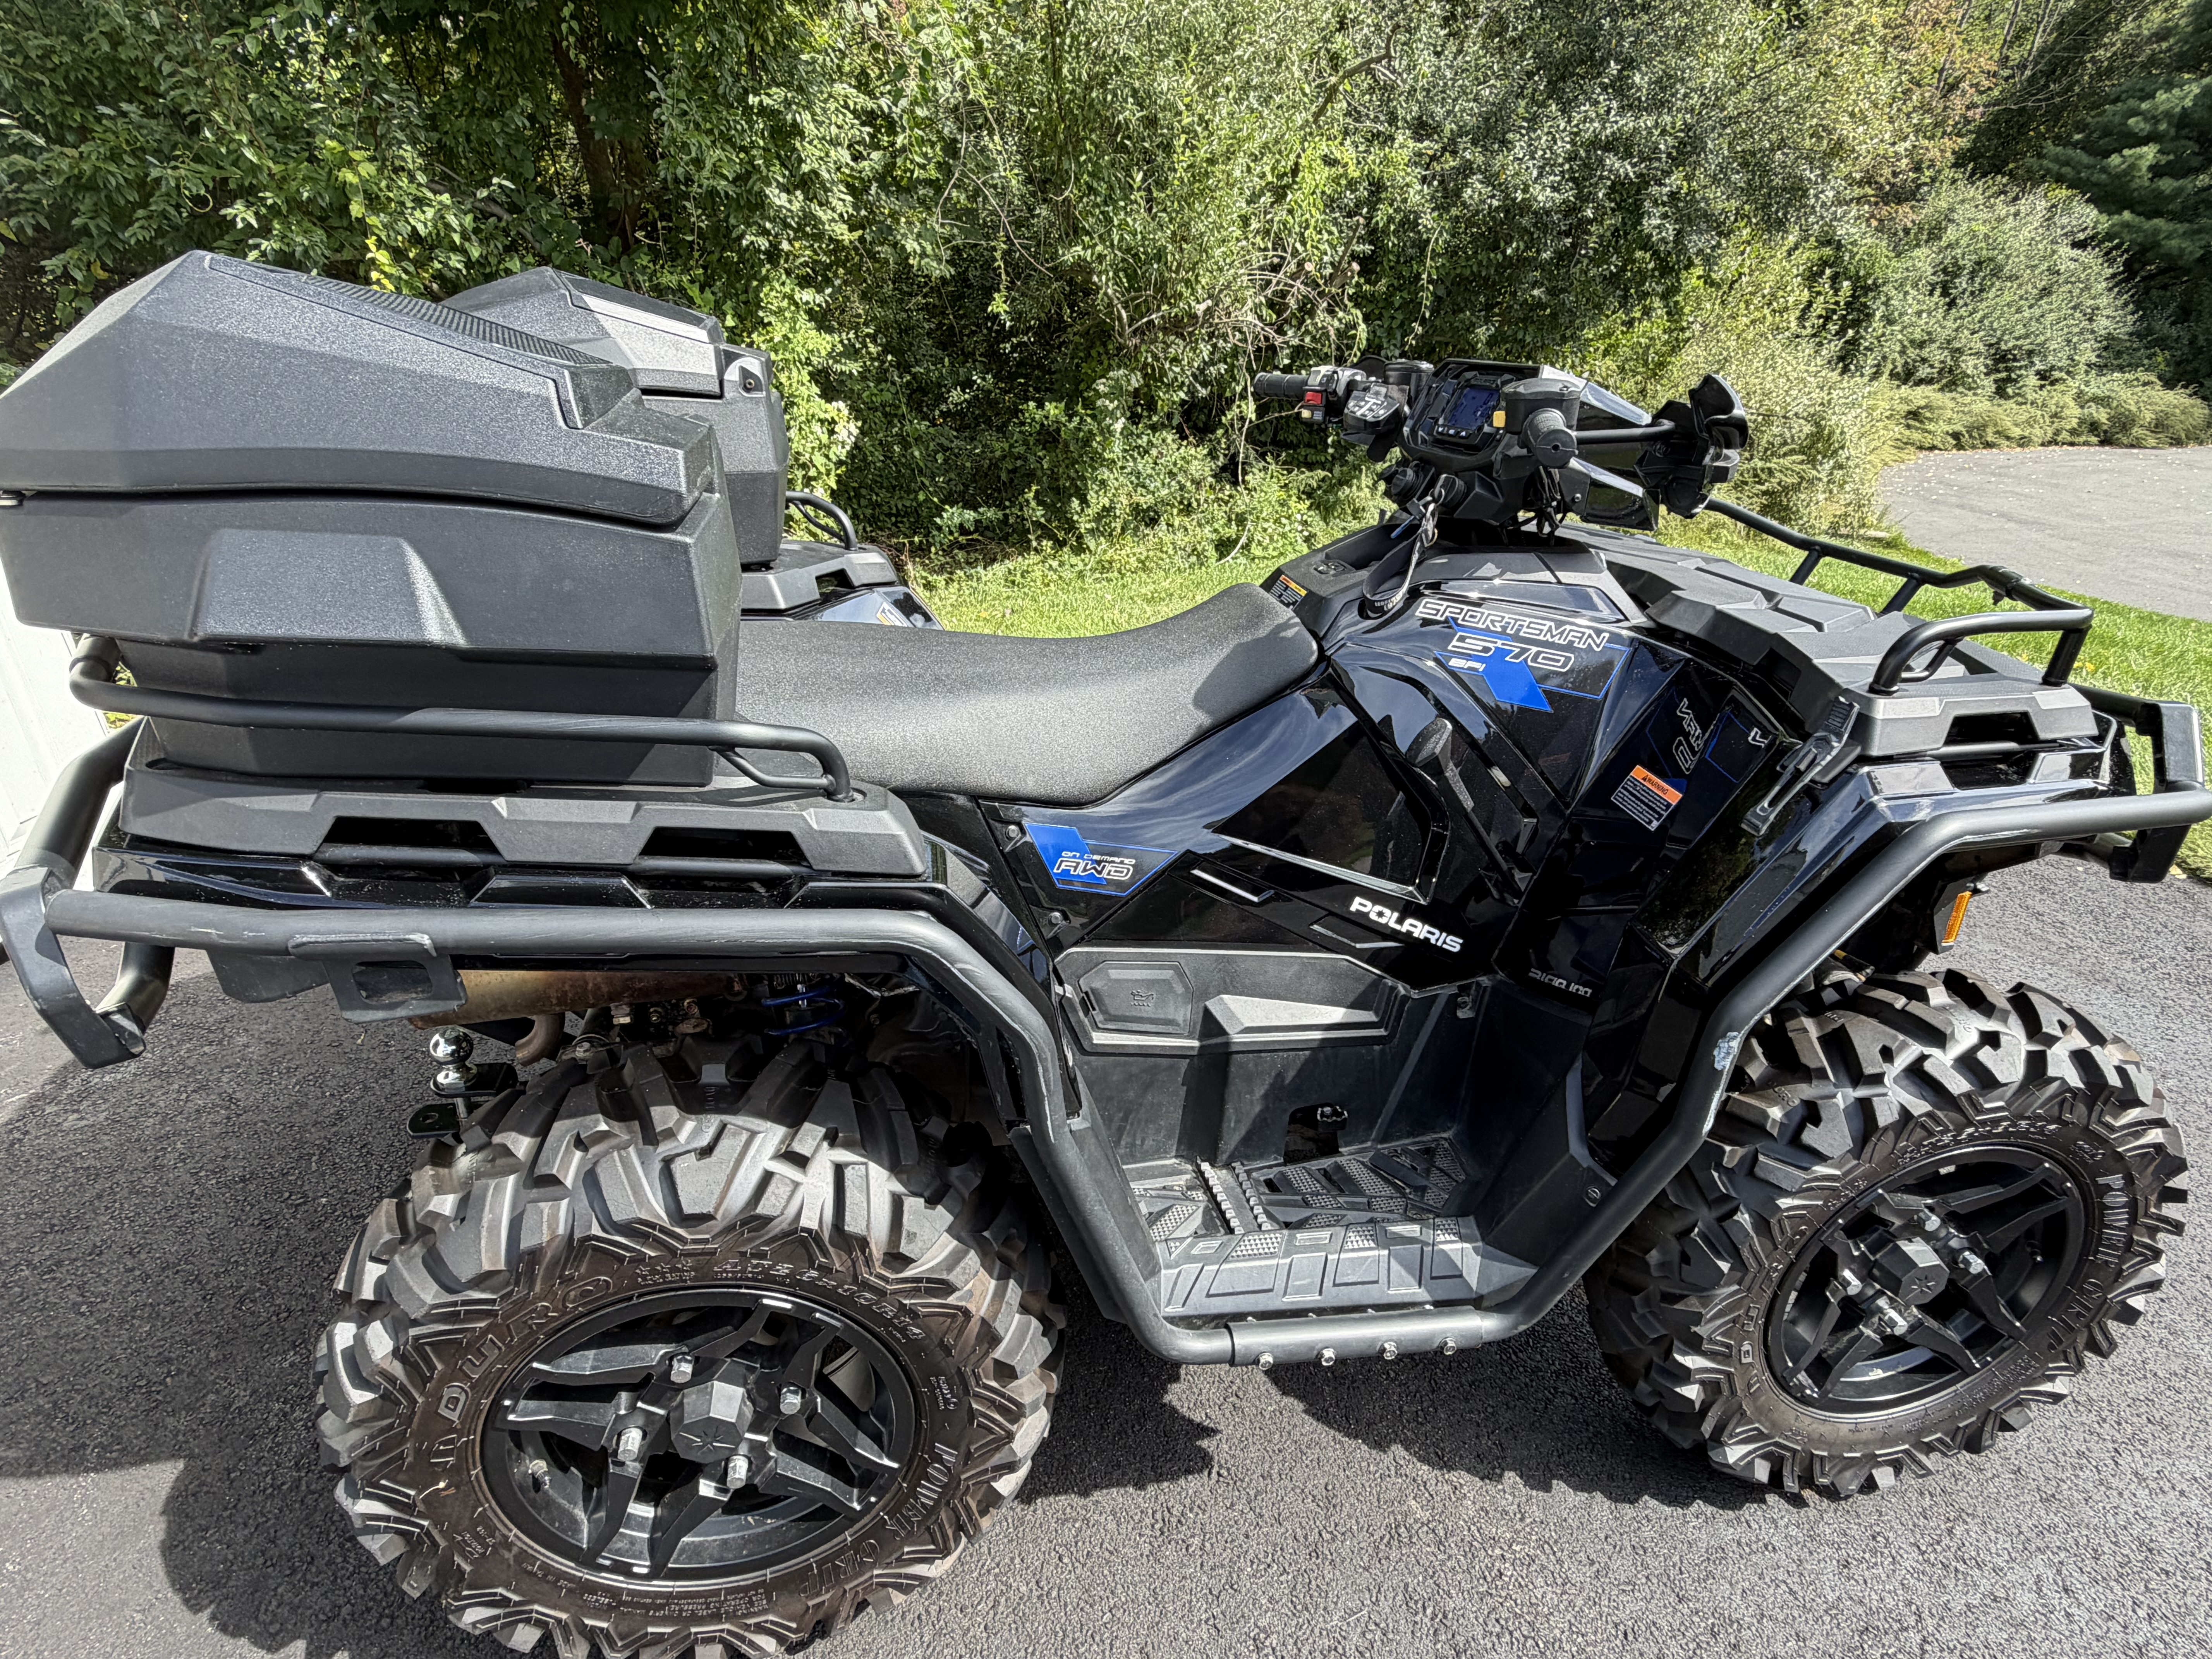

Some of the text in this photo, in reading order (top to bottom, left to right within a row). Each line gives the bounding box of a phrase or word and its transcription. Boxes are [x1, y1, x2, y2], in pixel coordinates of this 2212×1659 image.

[1415, 599, 1610, 651] SPORTSMAN
[1448, 632, 1574, 672] 570
[1448, 658, 1486, 672] EFI
[1646, 776, 1668, 795] WARNING
[1053, 857, 1133, 880] AWD
[1084, 854, 1135, 864] DEMAND
[1350, 896, 1463, 952] POLARIS
[437, 1276, 613, 1424] DURO
[800, 1443, 958, 1596] POWER GRIP
